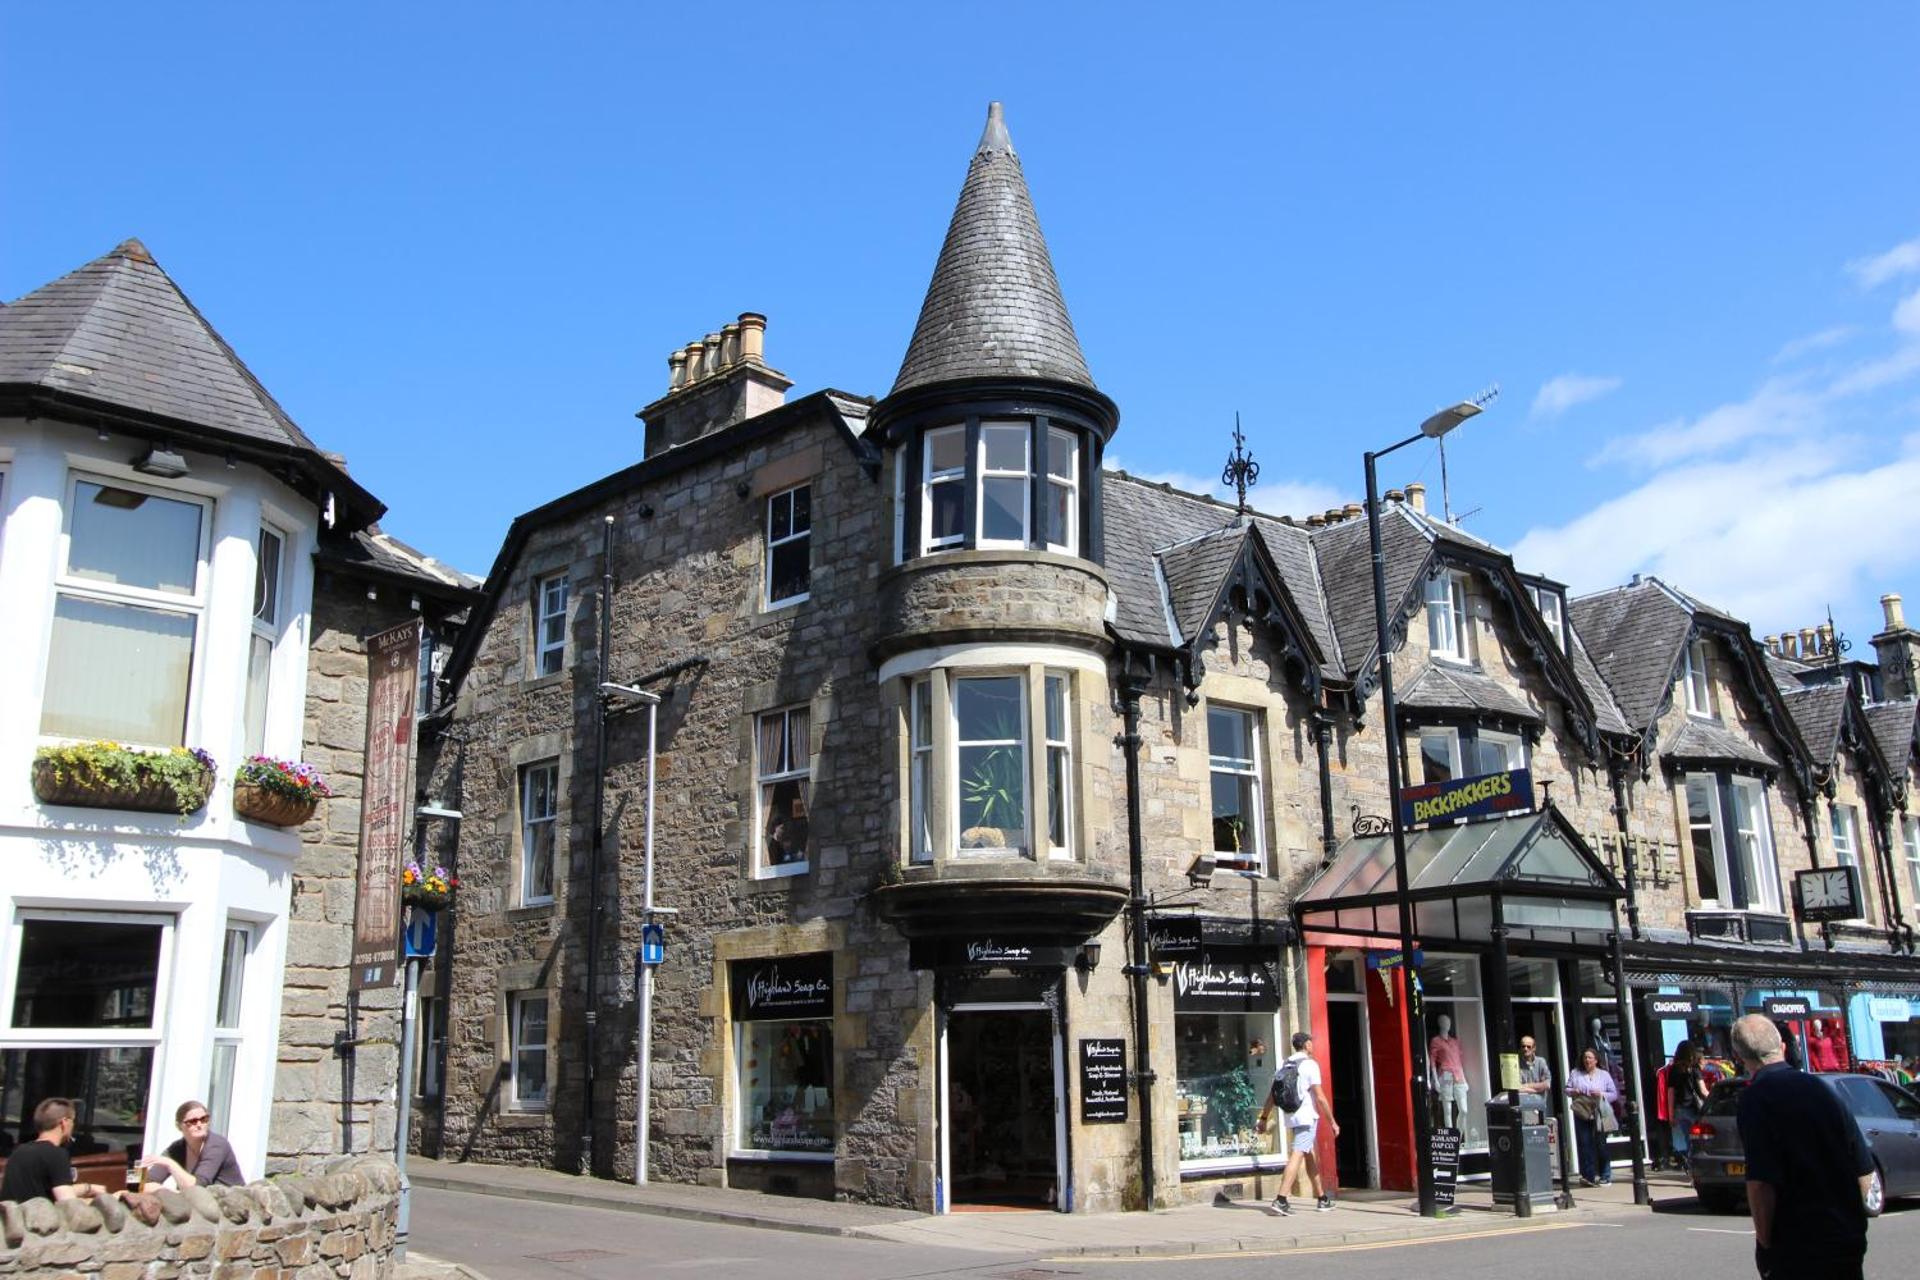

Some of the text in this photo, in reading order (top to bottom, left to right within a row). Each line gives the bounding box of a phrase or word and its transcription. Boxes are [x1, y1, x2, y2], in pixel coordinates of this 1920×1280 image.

[1414, 773, 1512, 822] BACKPACKERS
[1004, 946, 1020, 957] Soap
[758, 964, 831, 1002] Highland Soap Co.
[1188, 953, 1265, 990] Highland Soap Co.
[1653, 1001, 1692, 1013] CRAGHOPPERS
[1772, 1003, 1806, 1014] CRAGHOPPERS
